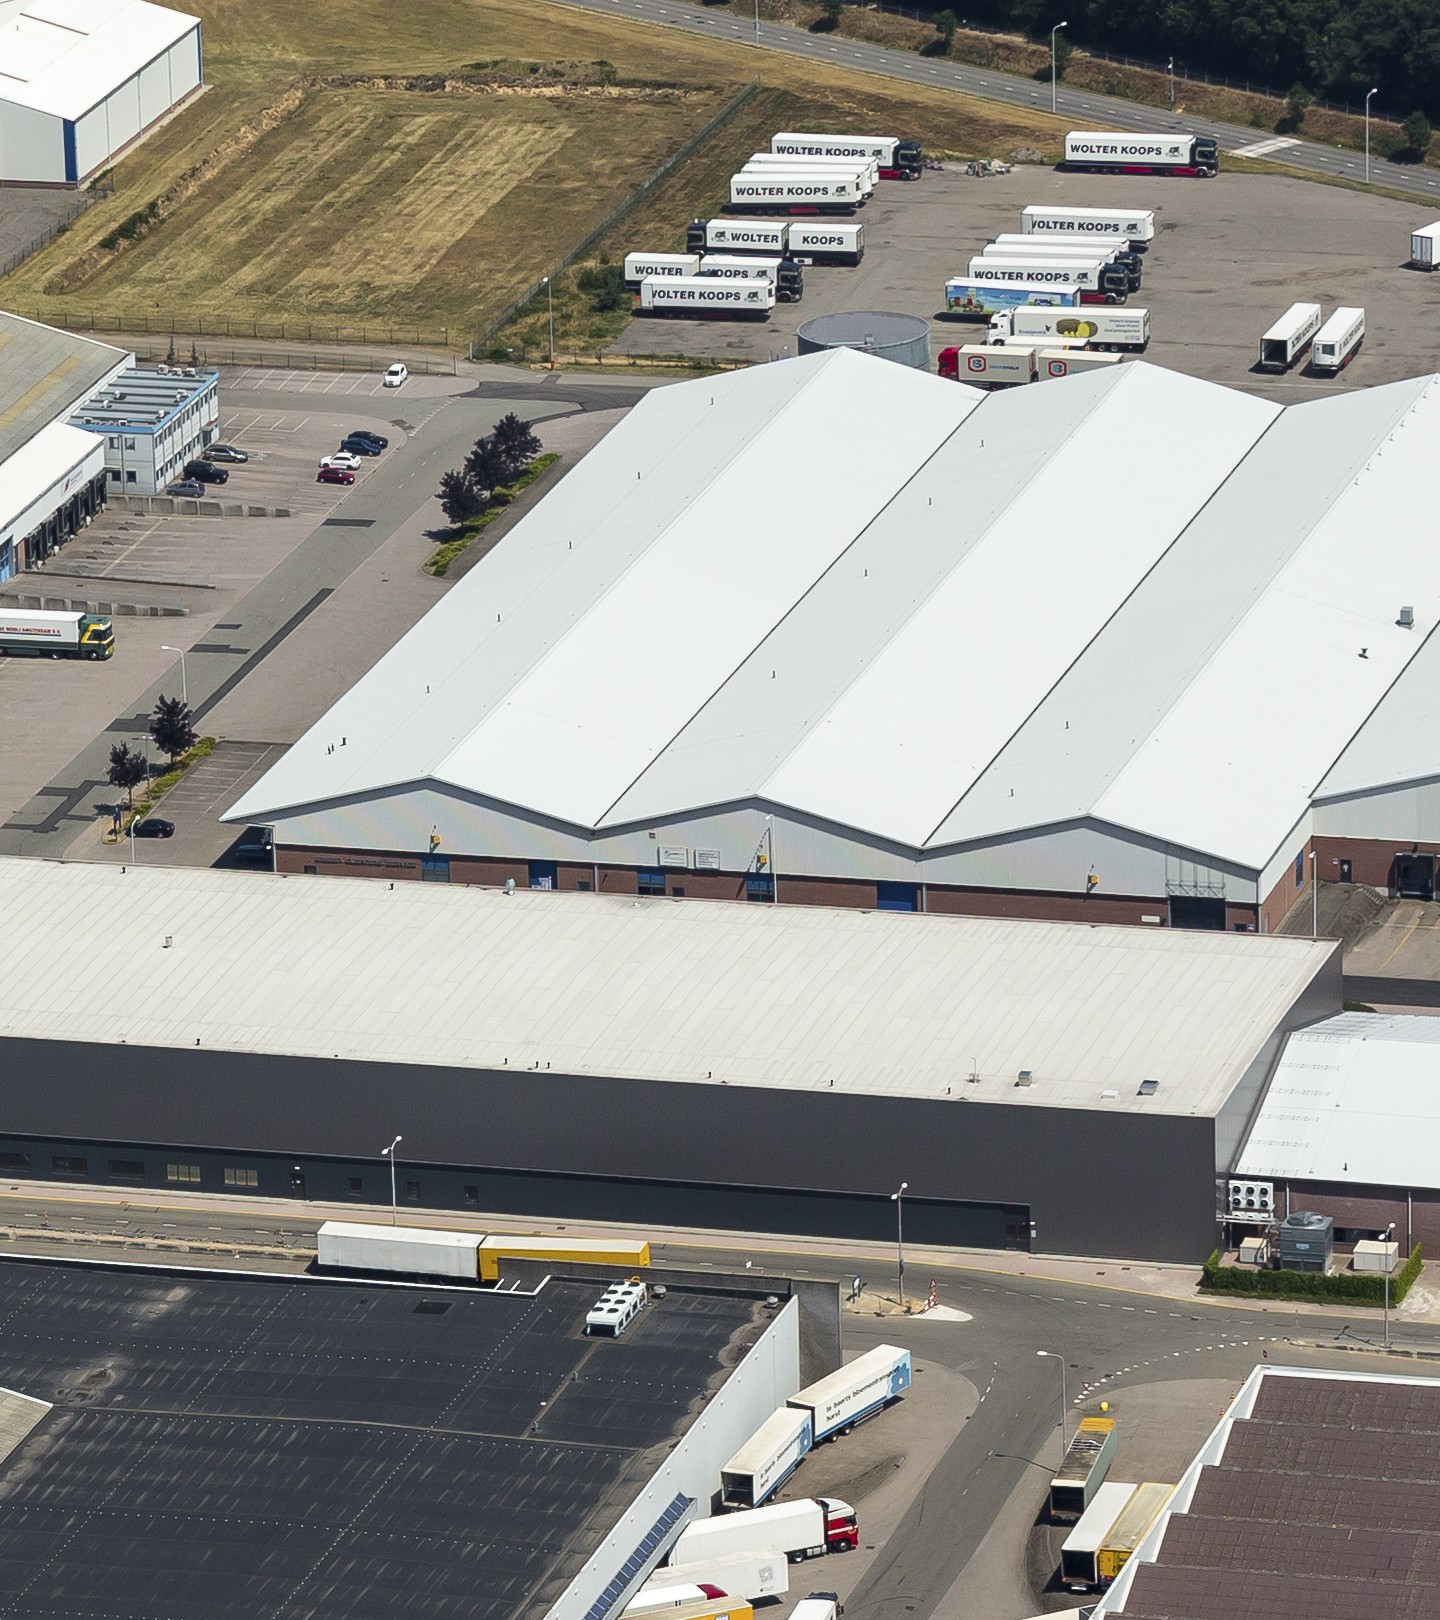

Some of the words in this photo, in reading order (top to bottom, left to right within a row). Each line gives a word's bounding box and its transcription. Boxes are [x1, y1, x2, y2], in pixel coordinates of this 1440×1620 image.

[776, 145, 822, 156] WOLTER
[825, 147, 866, 157] KOOPS
[1070, 144, 1118, 154] WOLTER
[1121, 146, 1162, 155] KOOPS
[735, 187, 784, 196] WOLTER
[787, 186, 829, 196] KOOPS
[1077, 222, 1119, 232] KOOPS
[731, 232, 779, 243] WOLTER
[802, 235, 844, 245] KOOPS
[634, 265, 683, 276] WOLTER
[717, 269, 749, 278] OOPS
[974, 270, 1024, 281] WOLTER
[1027, 272, 1070, 282] KOOPS
[698, 290, 741, 301] KOOPS
